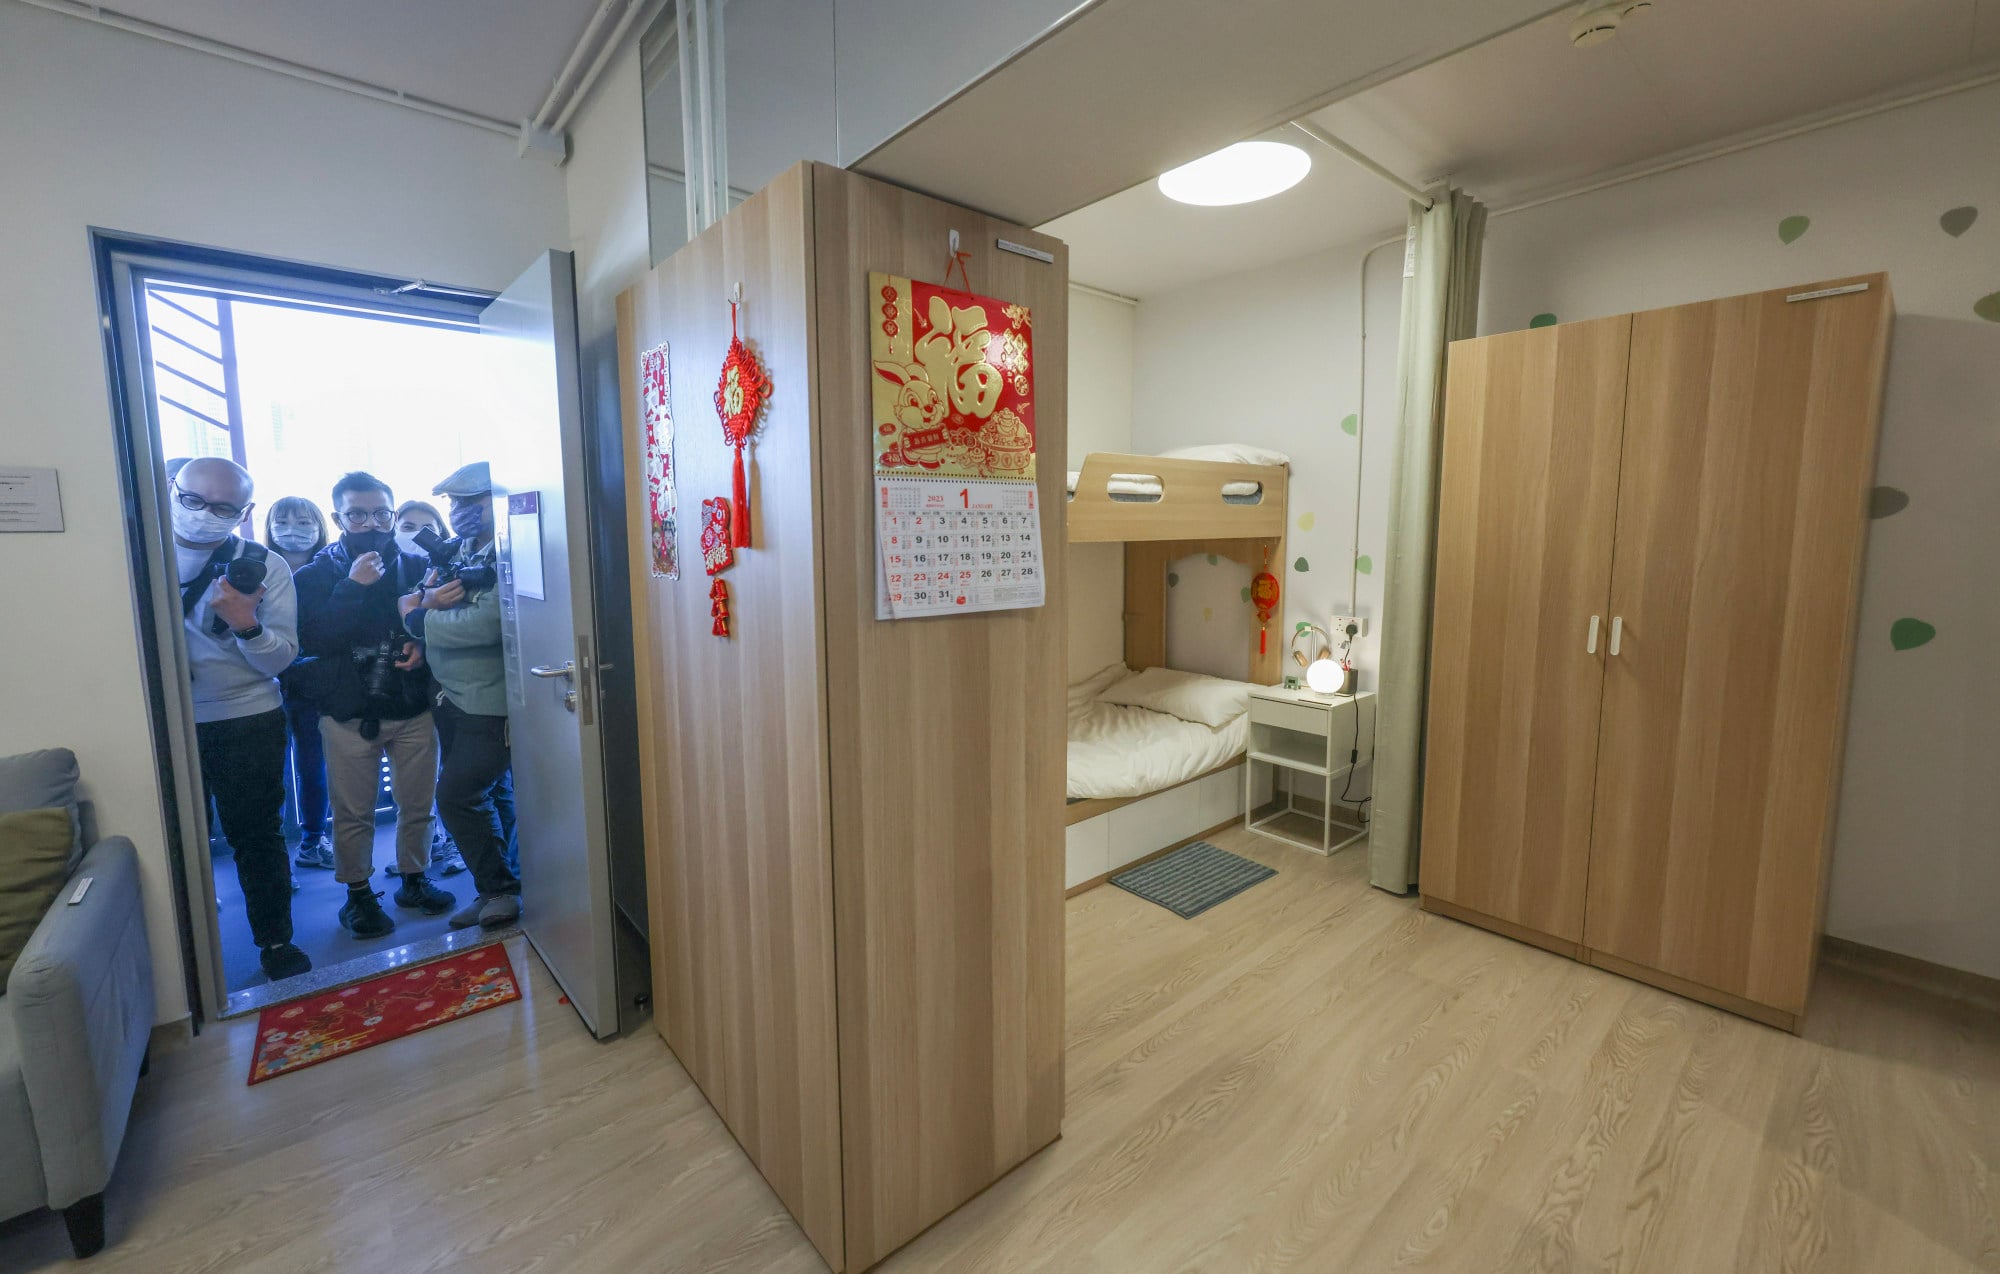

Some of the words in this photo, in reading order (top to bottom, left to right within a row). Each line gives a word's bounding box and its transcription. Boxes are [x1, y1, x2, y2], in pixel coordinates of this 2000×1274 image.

[914, 296, 1003, 418] 福
[960, 488, 969, 508] 1
[892, 517, 897, 525] 1
[916, 517, 922, 525] 2
[940, 517, 946, 525] 3
[961, 517, 967, 525] 4
[983, 517, 989, 525] 5
[1003, 517, 1008, 525] 6
[1022, 517, 1027, 525] 7
[892, 537, 898, 545] 8
[916, 536, 923, 544] 9
[938, 536, 948, 544] 10
[961, 535, 969, 543] 11
[981, 535, 991, 543] 12
[1001, 534, 1010, 542] 13
[914, 555, 926, 563] 16
[938, 554, 948, 562] 17
[1001, 552, 1010, 560] 20
[1021, 551, 1031, 559] 21
[891, 575, 901, 583] 22
[914, 574, 926, 582] 23
[960, 571, 971, 579] 25
[981, 570, 991, 578] 26
[1001, 569, 1011, 577] 27
[1022, 568, 1033, 576] 28
[915, 592, 926, 600] 30
[939, 591, 949, 599] 31
